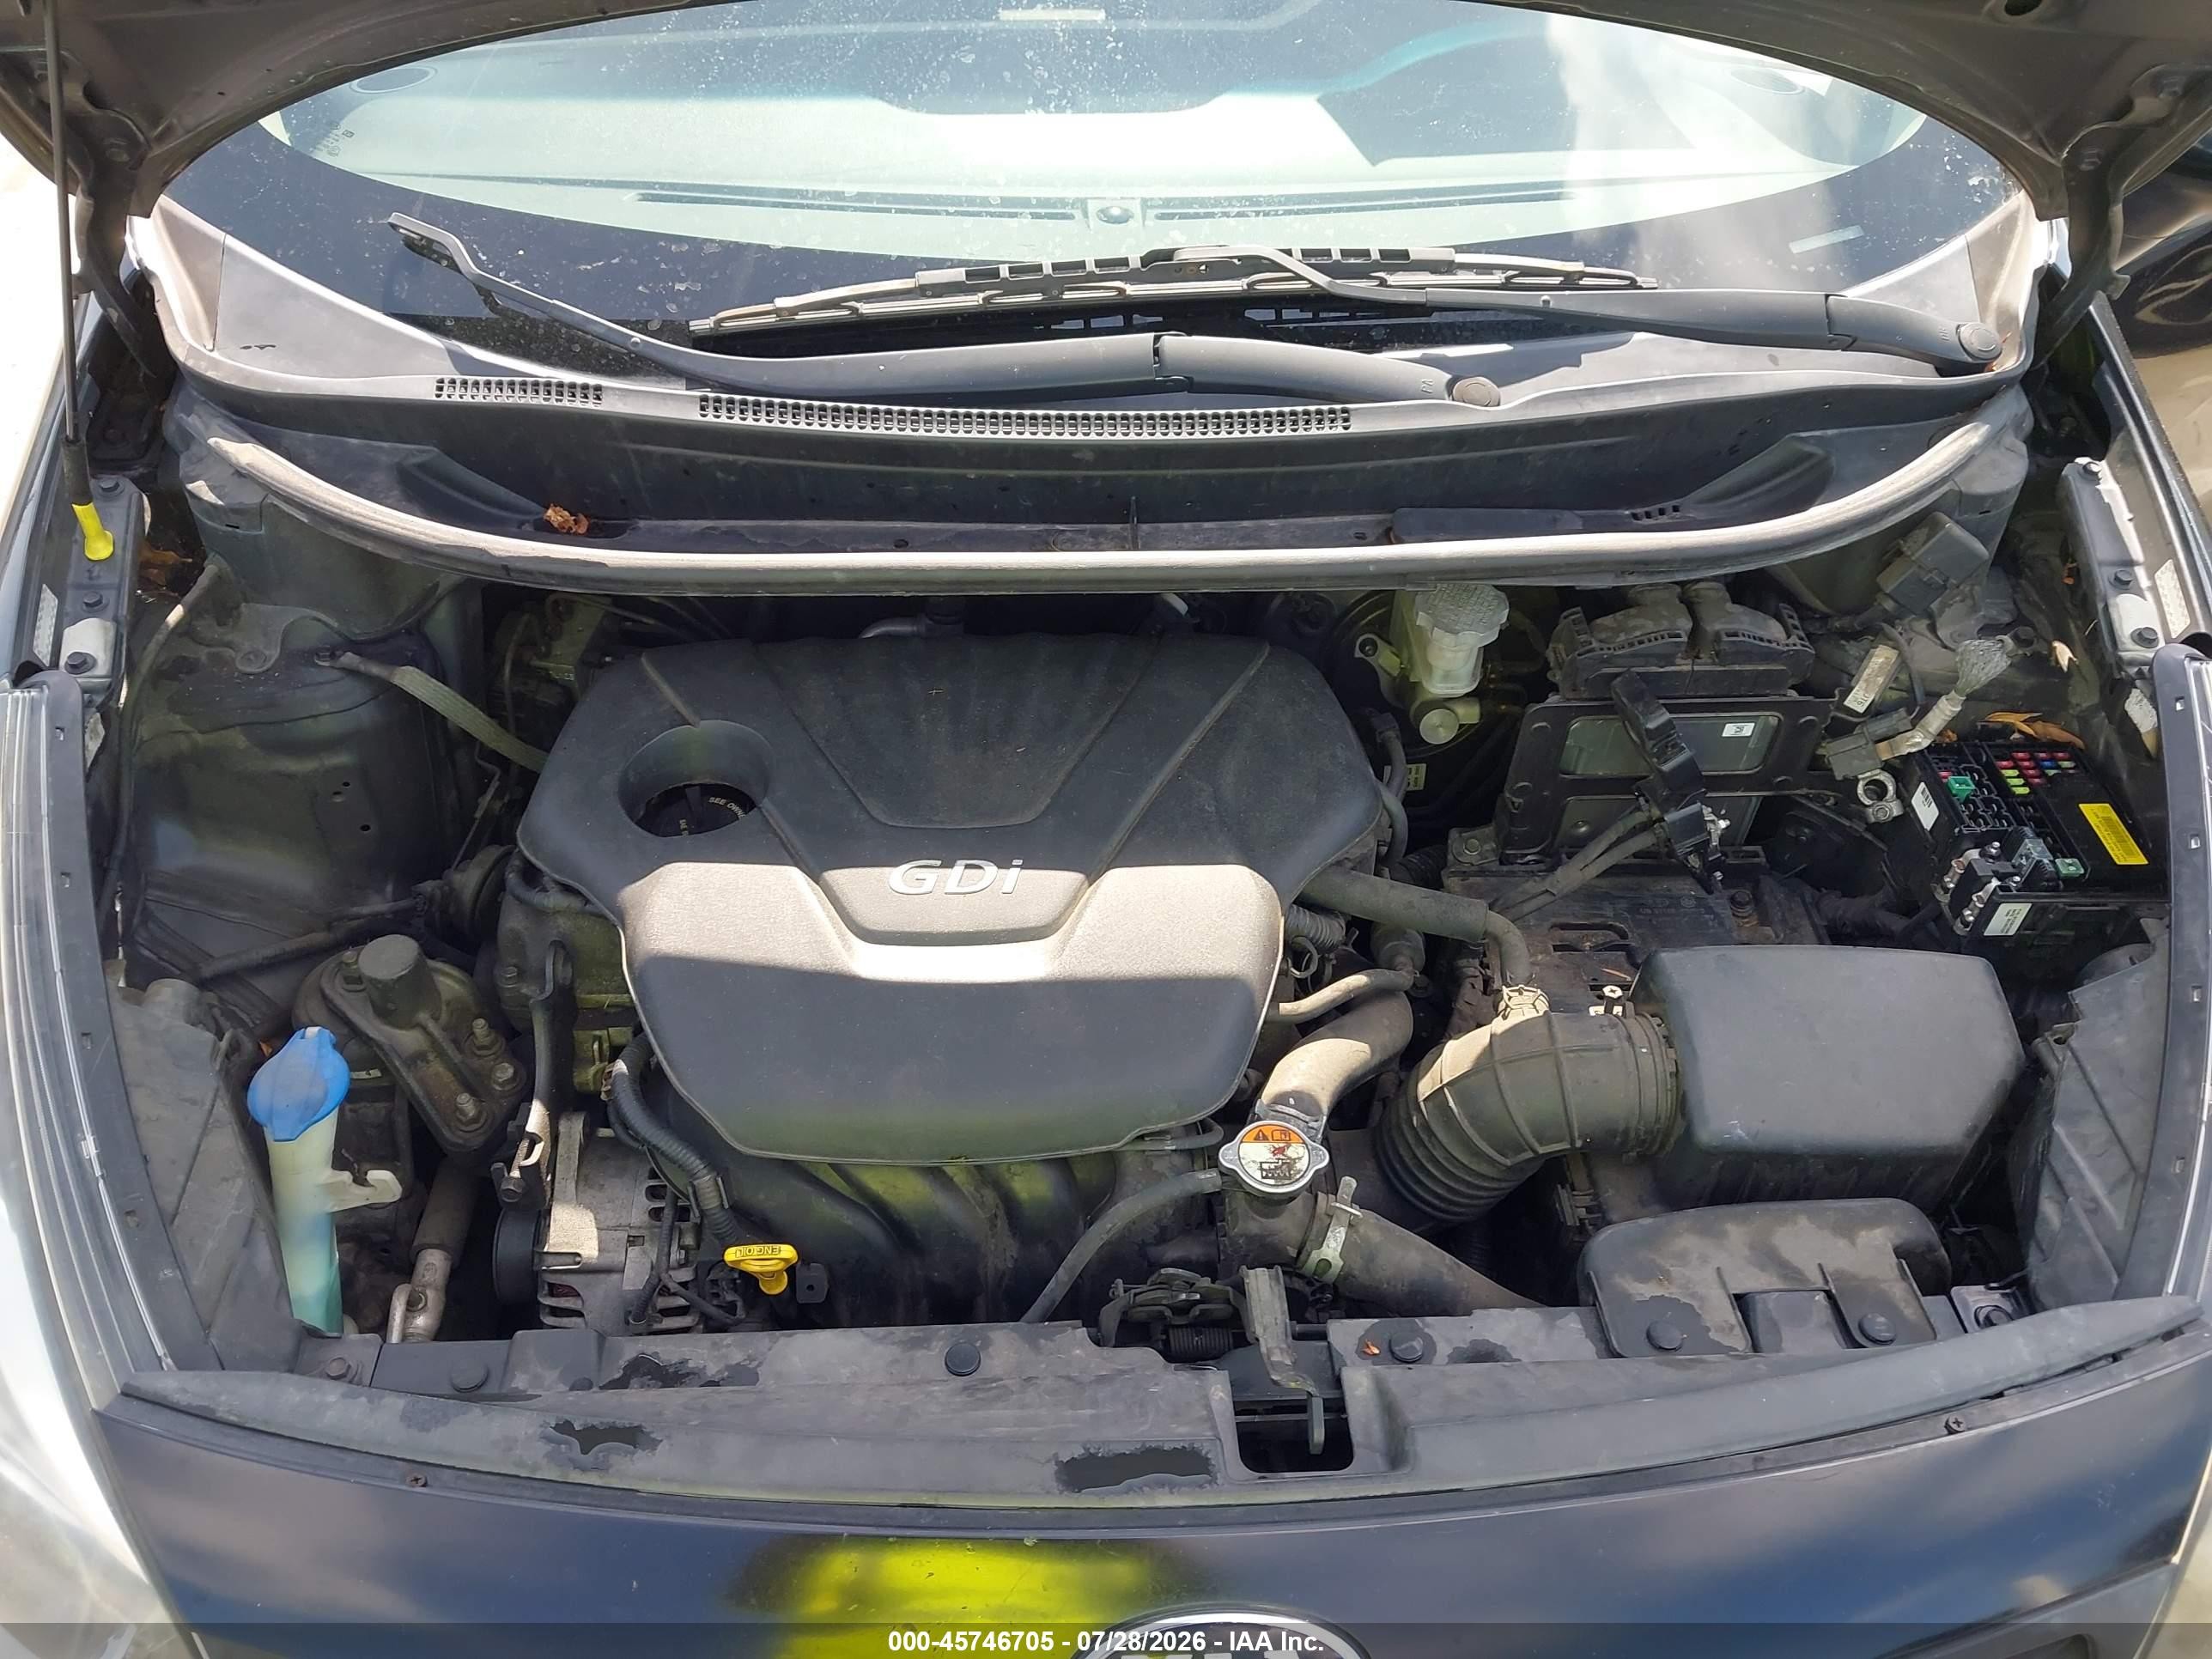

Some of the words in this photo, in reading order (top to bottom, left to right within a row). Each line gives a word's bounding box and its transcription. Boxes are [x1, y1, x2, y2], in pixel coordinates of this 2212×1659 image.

[708, 797, 727, 805] SEE
[888, 859, 1024, 895] GDi
[735, 1247, 755, 1258] OIL
[757, 1245, 781, 1256] ENG
